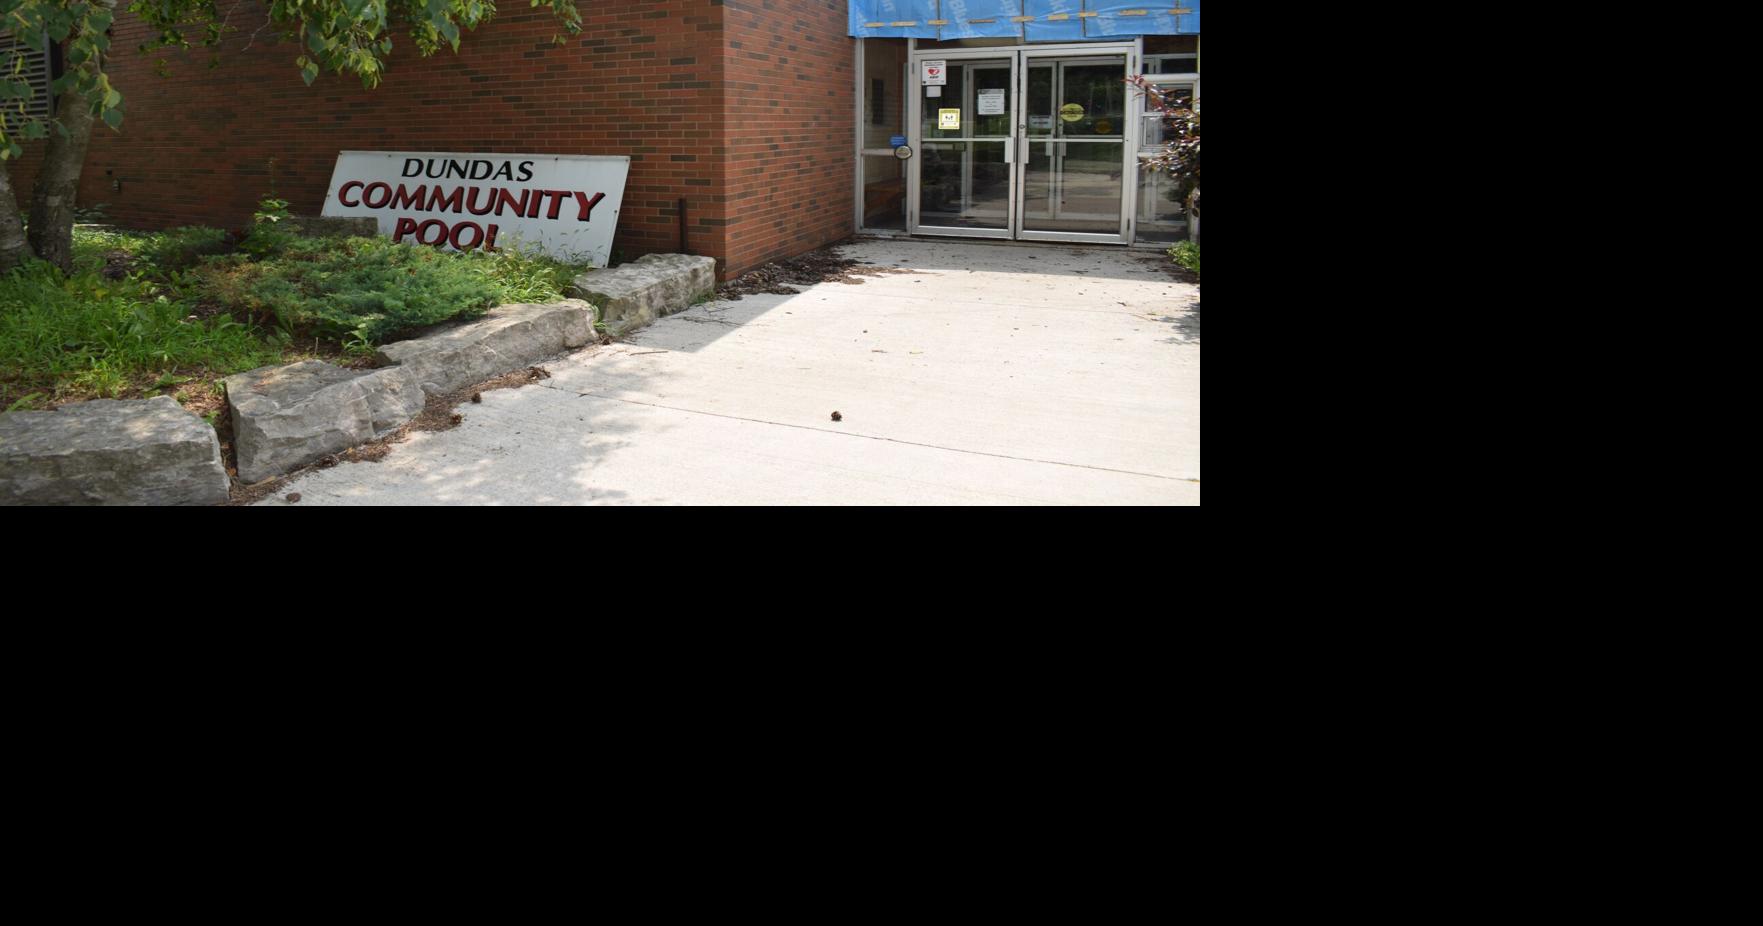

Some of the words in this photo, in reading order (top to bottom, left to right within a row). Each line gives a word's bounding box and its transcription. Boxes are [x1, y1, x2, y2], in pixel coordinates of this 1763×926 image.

[401, 158, 534, 182] DUNDAS
[338, 180, 606, 222] COMMUNITY
[393, 217, 502, 252] POOL
